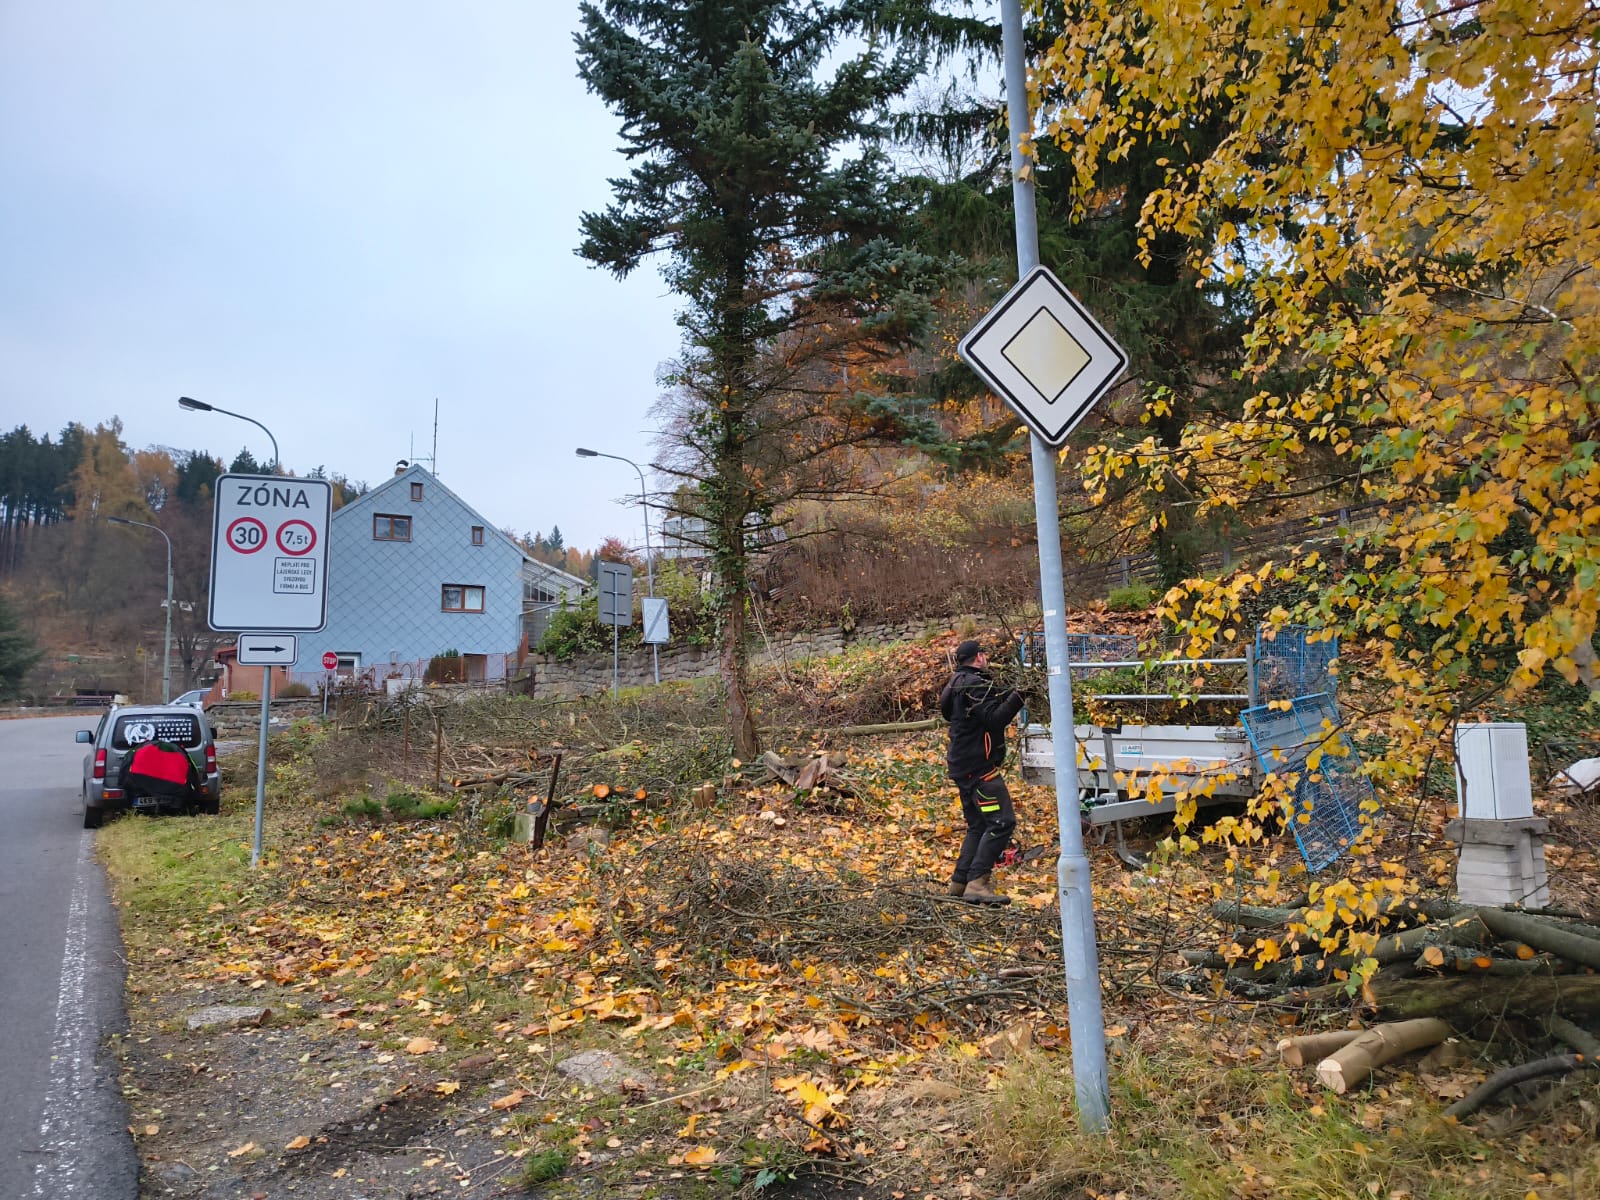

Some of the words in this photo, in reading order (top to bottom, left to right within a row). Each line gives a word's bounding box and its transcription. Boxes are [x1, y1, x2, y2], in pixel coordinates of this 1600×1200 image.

[237, 483, 310, 509] ZÓNA
[235, 526, 260, 545] 30
[323, 656, 337, 664] STOP
